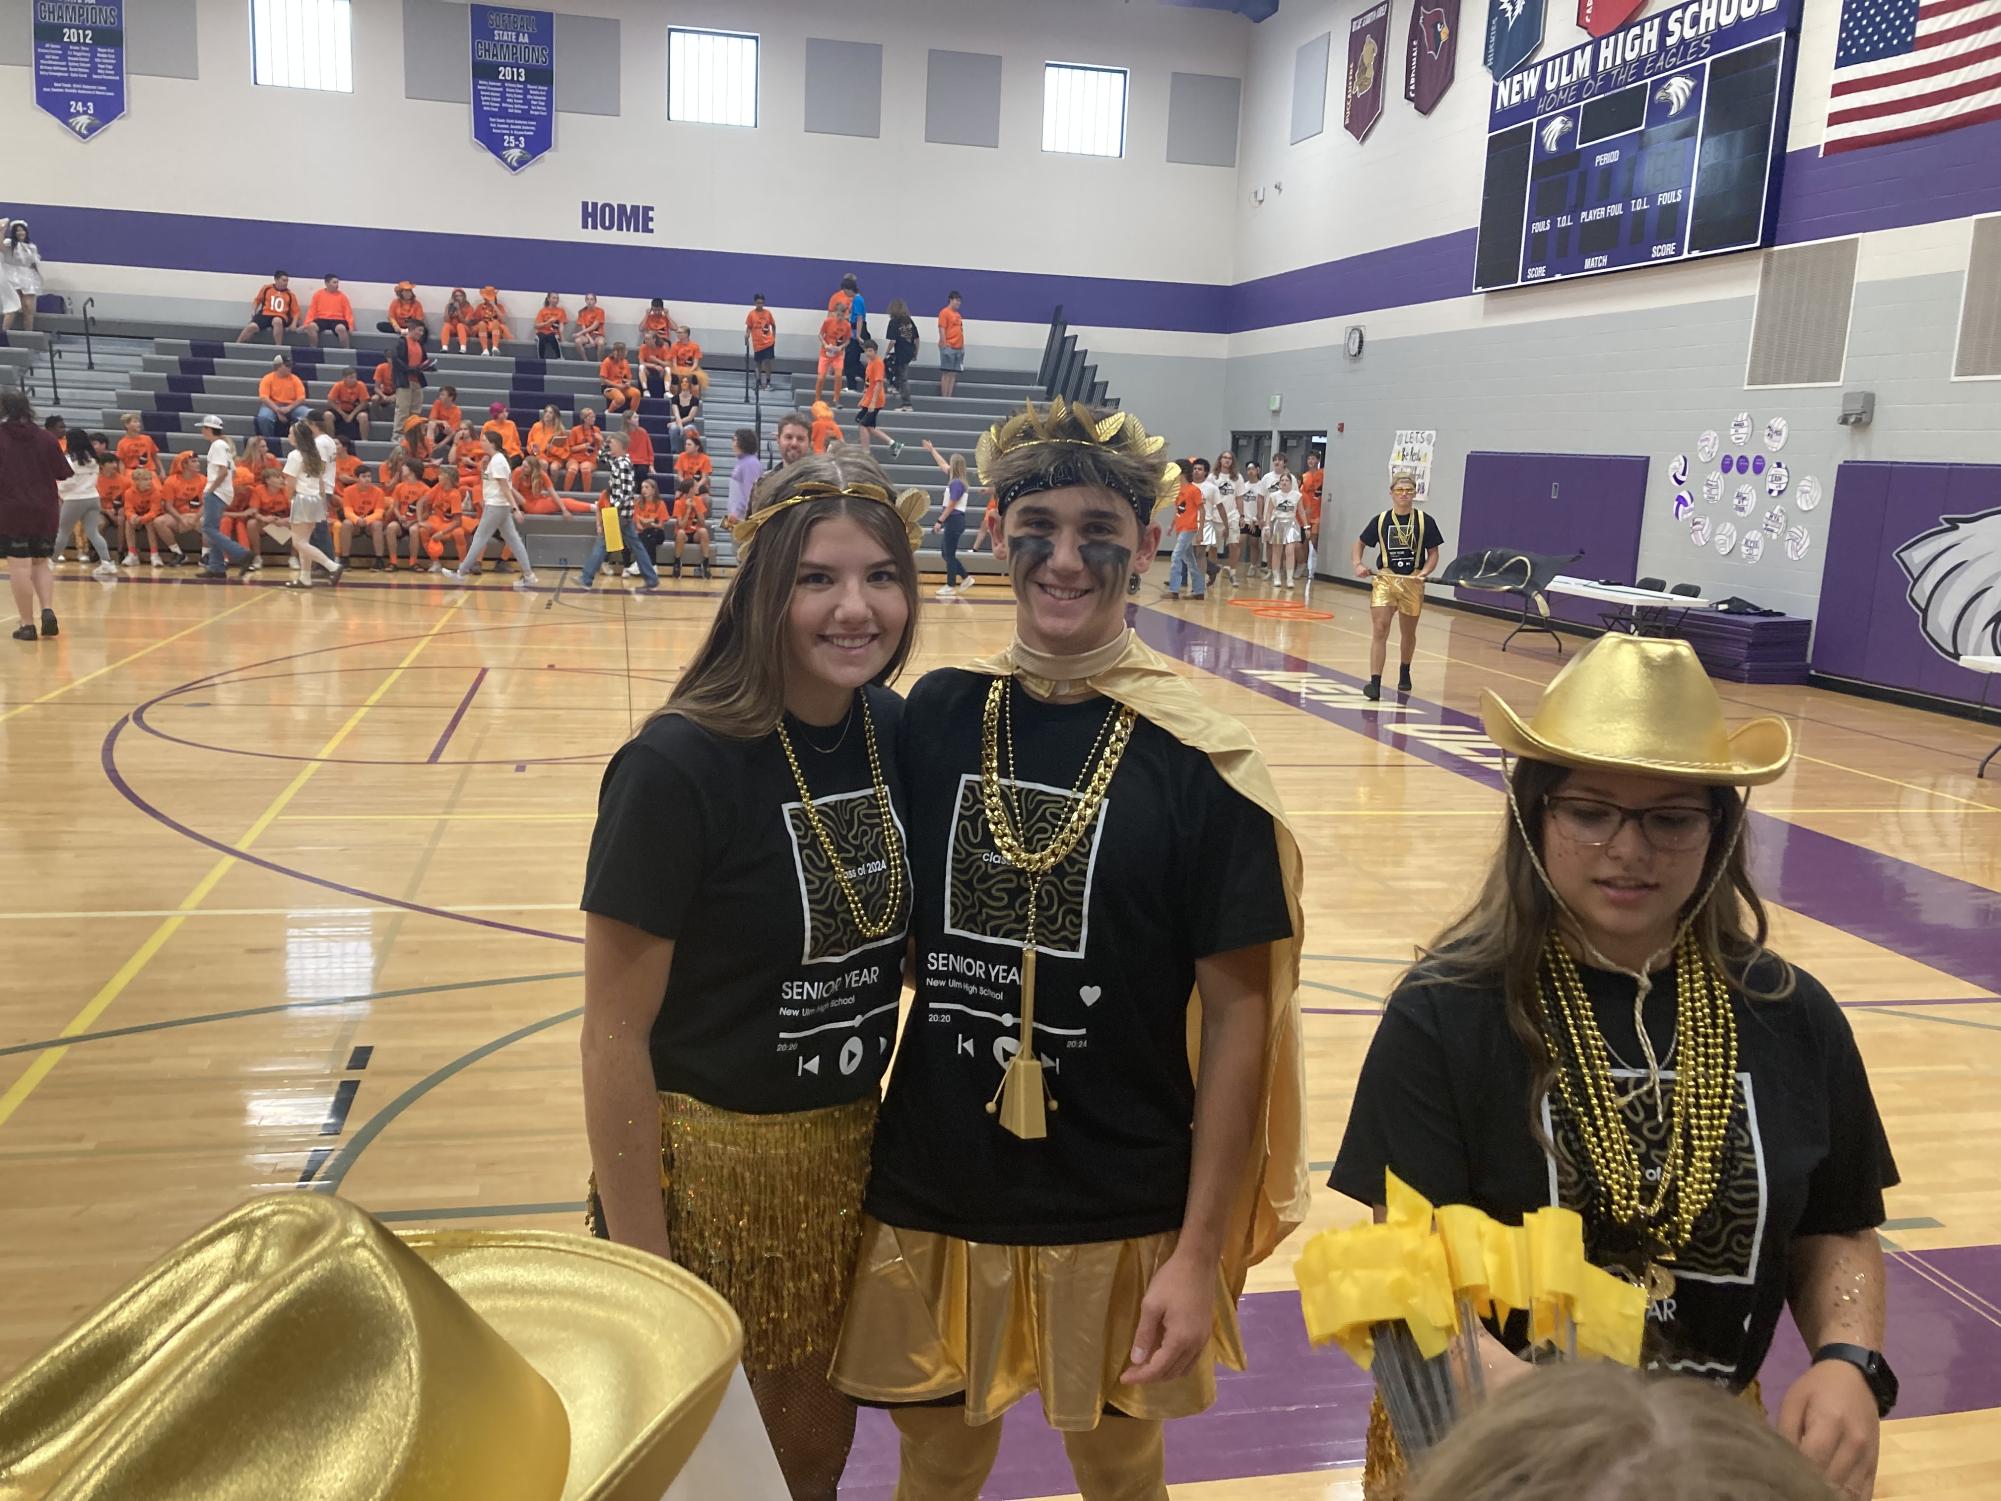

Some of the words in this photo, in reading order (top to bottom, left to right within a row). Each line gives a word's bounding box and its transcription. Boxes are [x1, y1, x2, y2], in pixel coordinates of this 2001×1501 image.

[39, 2, 117, 26] CHAMPIONS
[488, 12, 537, 32] SOFTBALL
[63, 28, 93, 44] 2012
[494, 30, 516, 42] STATE
[518, 32, 529, 43] AA
[476, 40, 548, 65] CHAMPIONS
[498, 66, 525, 81] 2013
[1495, 70, 1542, 110] NEW
[1545, 45, 1593, 91] ULM
[1598, 20, 1660, 72] HIGH
[1537, 85, 1577, 114] HOME
[1582, 73, 1604, 98] OF
[1609, 65, 1638, 90] THE
[1644, 36, 1711, 76] EAGLES
[69, 101, 94, 114] 24-3
[503, 136, 525, 148] 25-3
[1595, 150, 1620, 167] PERIOD
[581, 201, 655, 233] HOME
[1531, 219, 1551, 234] FOULS
[1557, 214, 1573, 228] T.O.L.
[1580, 207, 1605, 223] PLAYER
[1606, 203, 1624, 218] FOUL
[1631, 197, 1650, 212] T.O.L.
[1657, 190, 1682, 206] FOULS
[1527, 265, 1547, 279] SCORE
[1584, 255, 1608, 270] MATCH
[1651, 242, 1677, 259] SCORE
[270, 295, 284, 313] 10
[1404, 431, 1425, 444] LETS
[857, 864, 865, 876] of
[866, 859, 887, 874] 2024
[927, 952, 986, 979] SENIOR
[988, 964, 1023, 986] YEA
[781, 976, 842, 1000] SENIOR
[844, 966, 880, 989] YEAR
[926, 977, 946, 987] New
[948, 978, 963, 989] Ulm
[963, 983, 978, 995] High
[979, 986, 1004, 1001] School
[779, 1007, 800, 1017] New
[801, 1008, 816, 1017] Ulm
[928, 1013, 951, 1023] 20:20
[1066, 1040, 1088, 1048] 20:24
[1645, 1167, 1662, 1181] of
[1646, 1299, 1677, 1322] AR
